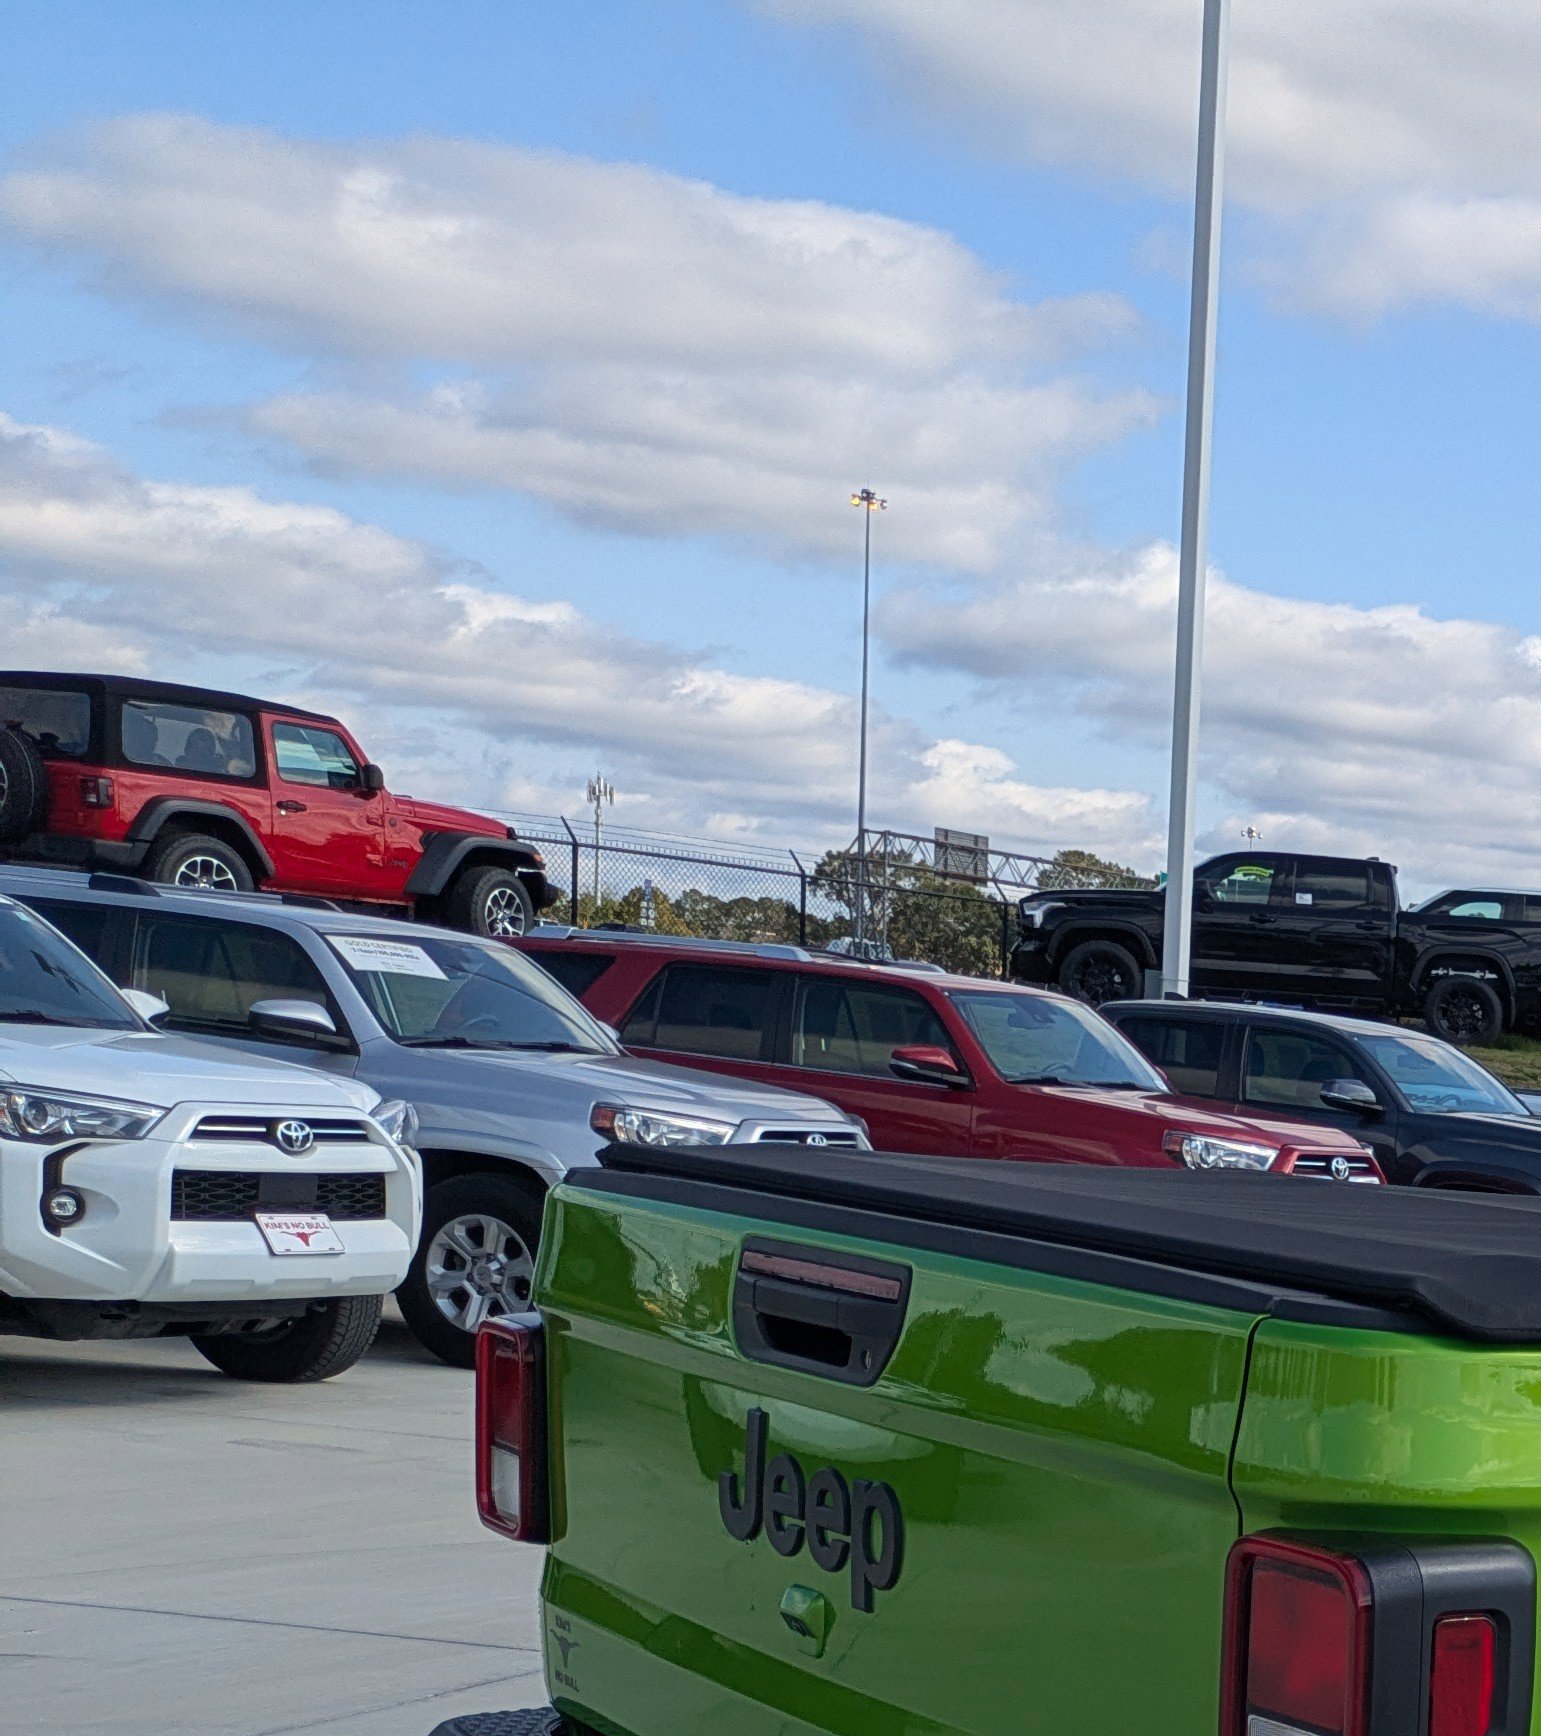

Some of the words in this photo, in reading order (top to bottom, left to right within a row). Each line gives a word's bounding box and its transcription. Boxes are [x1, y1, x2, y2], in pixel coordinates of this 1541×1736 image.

[263, 1222, 291, 1230] KIM'S
[291, 1222, 305, 1230] NO
[307, 1222, 330, 1230] BULL
[718, 1406, 904, 1613] Jeep
